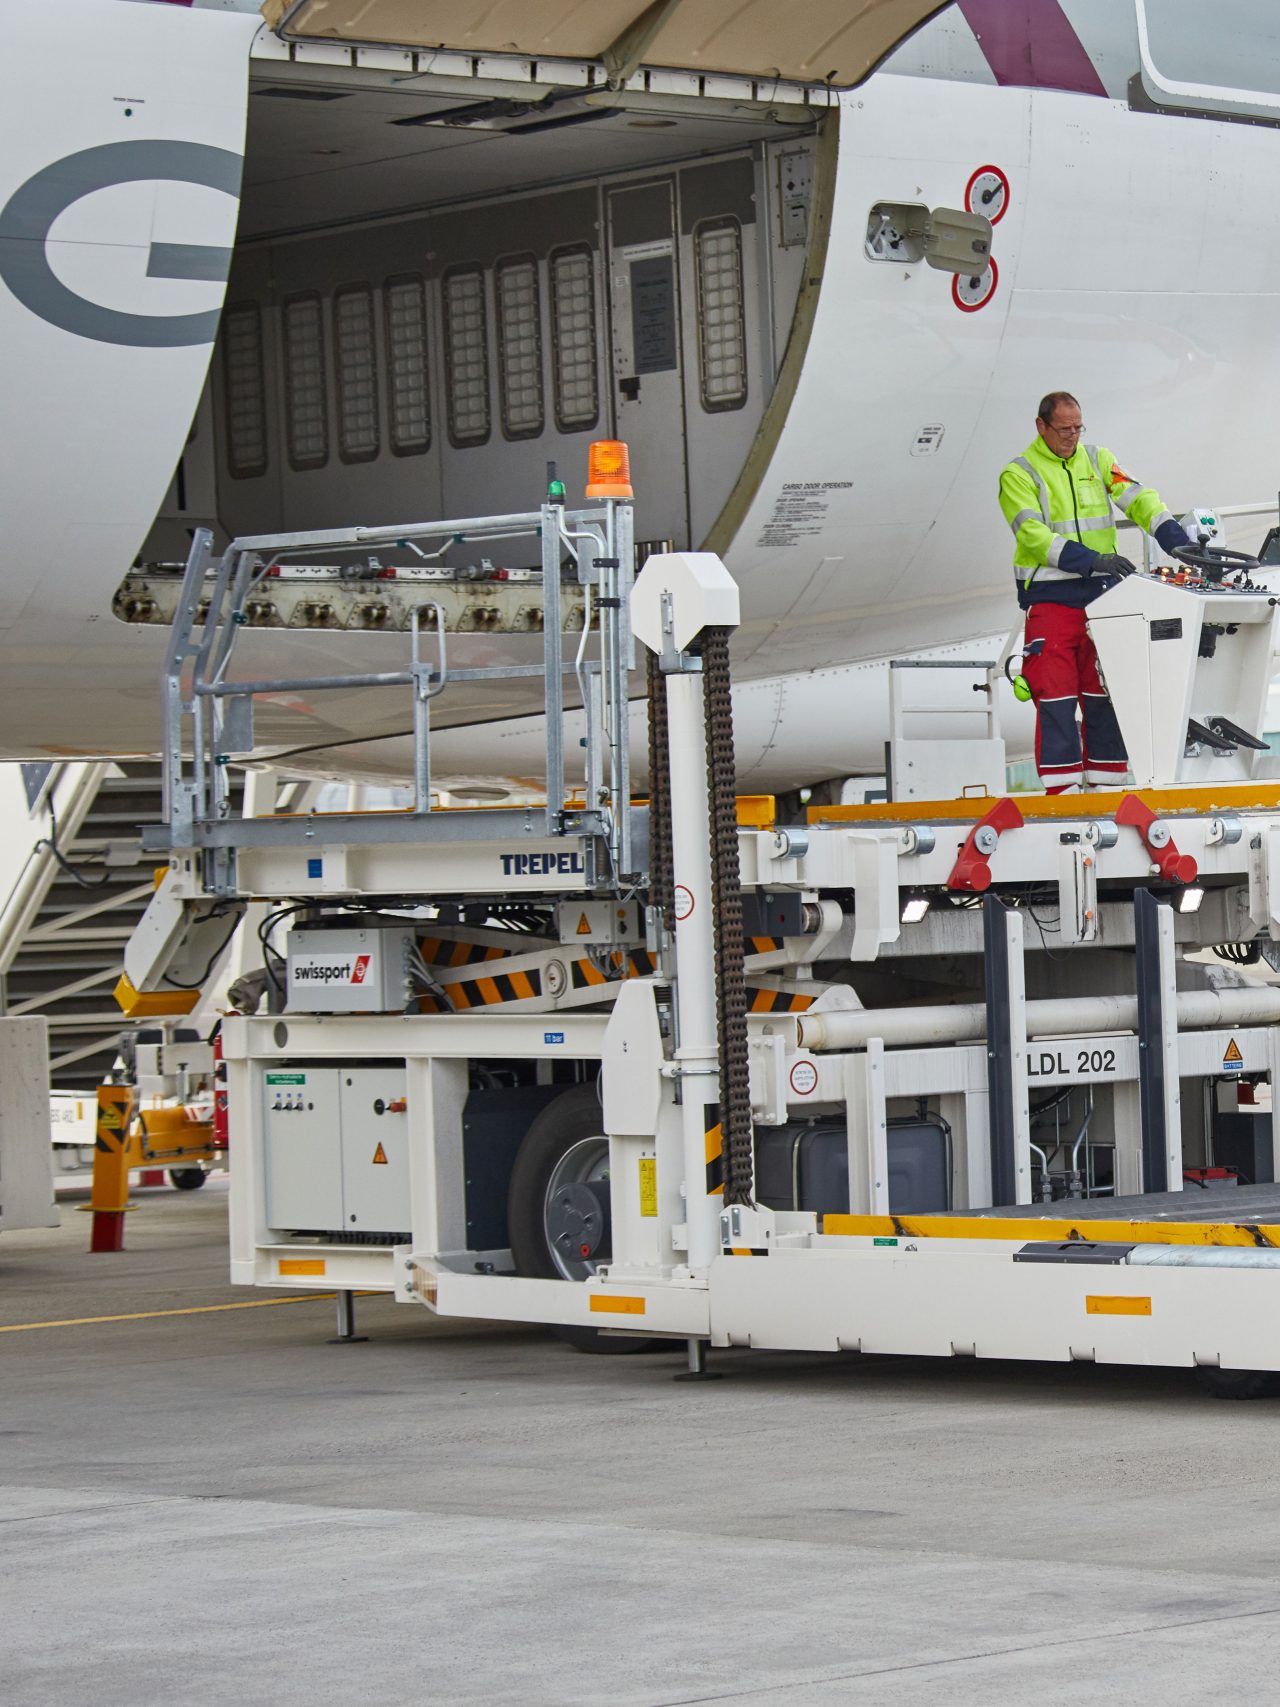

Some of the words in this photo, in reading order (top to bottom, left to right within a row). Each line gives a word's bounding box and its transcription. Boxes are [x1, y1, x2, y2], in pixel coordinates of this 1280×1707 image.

[821, 481, 854, 489] OPERATION
[500, 852, 585, 876] TREPEL
[294, 960, 351, 984] swissport
[1026, 1052, 1070, 1077] LDL
[1077, 1049, 1116, 1074] 202
